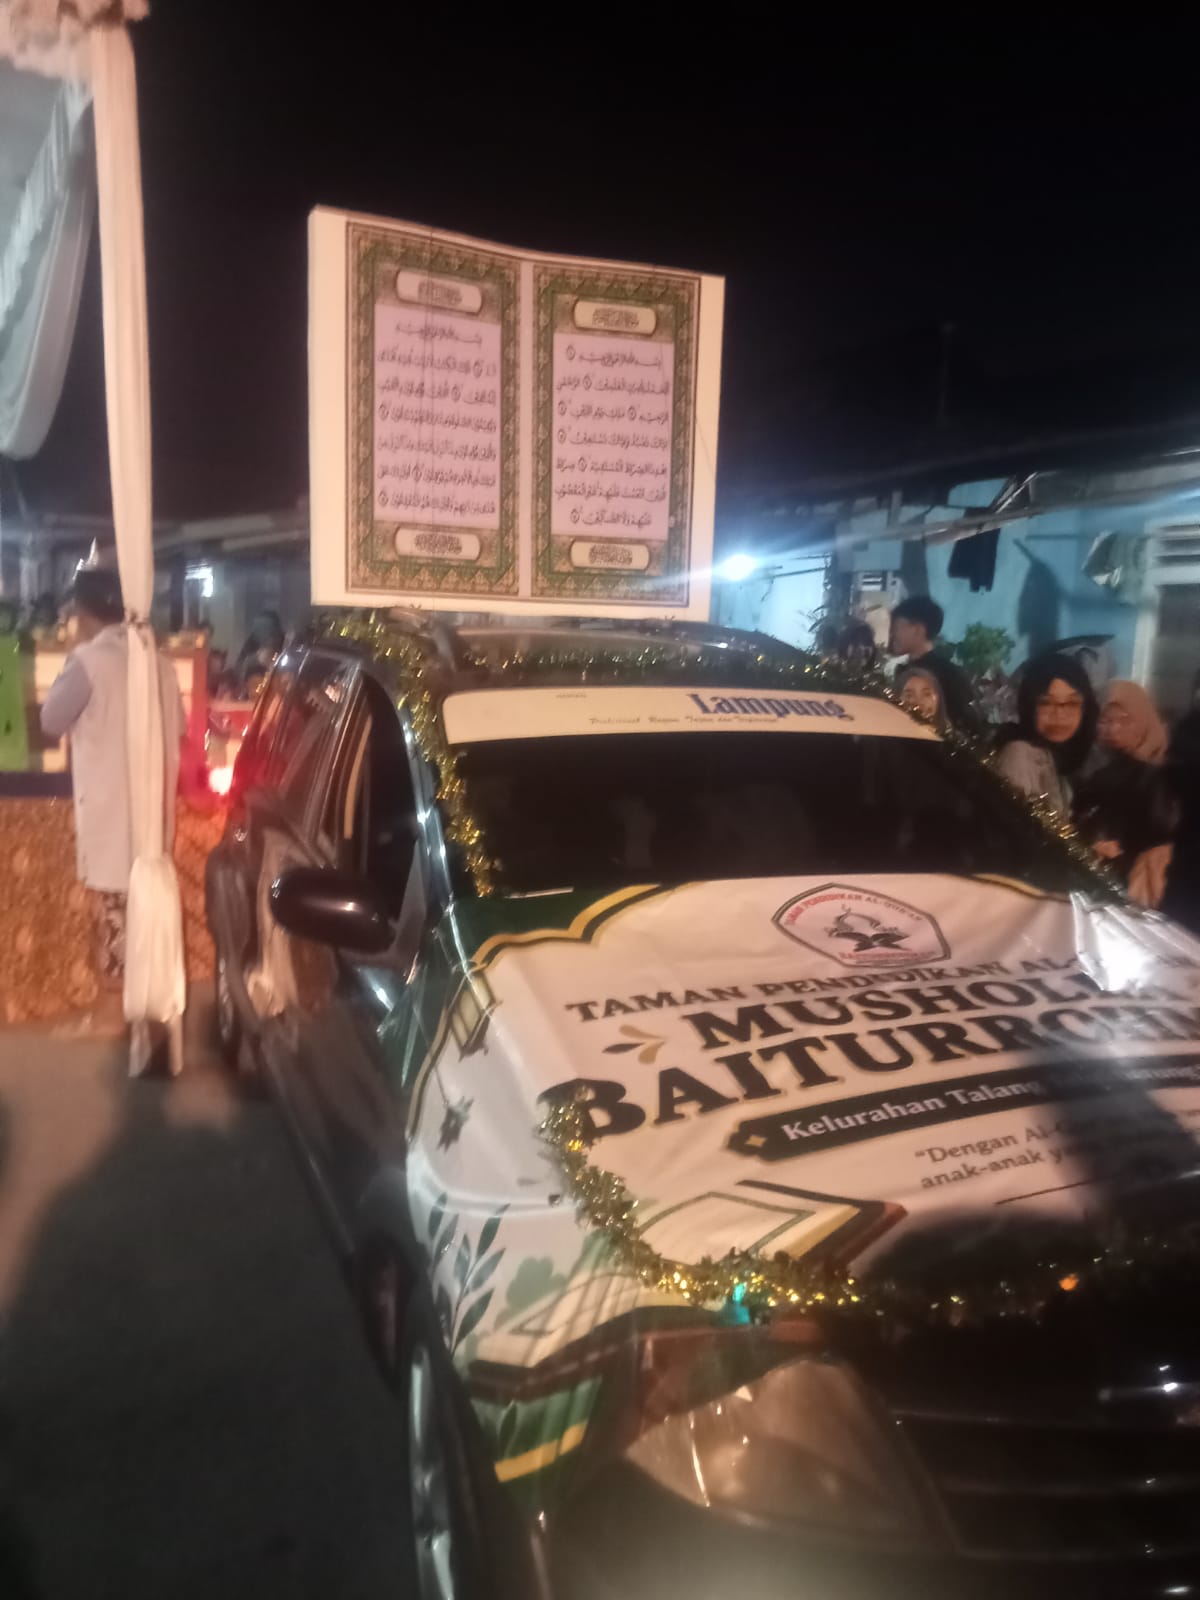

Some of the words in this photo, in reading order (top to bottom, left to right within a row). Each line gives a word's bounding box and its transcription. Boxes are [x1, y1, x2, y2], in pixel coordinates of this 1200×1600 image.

[686, 693, 854, 721] Lampung
[565, 985, 748, 1022] TAMAN
[753, 960, 1011, 997] PENDIDIKAN
[781, 1095, 944, 1142] Kelurahan
[920, 1148, 1044, 1190] anak-anak
